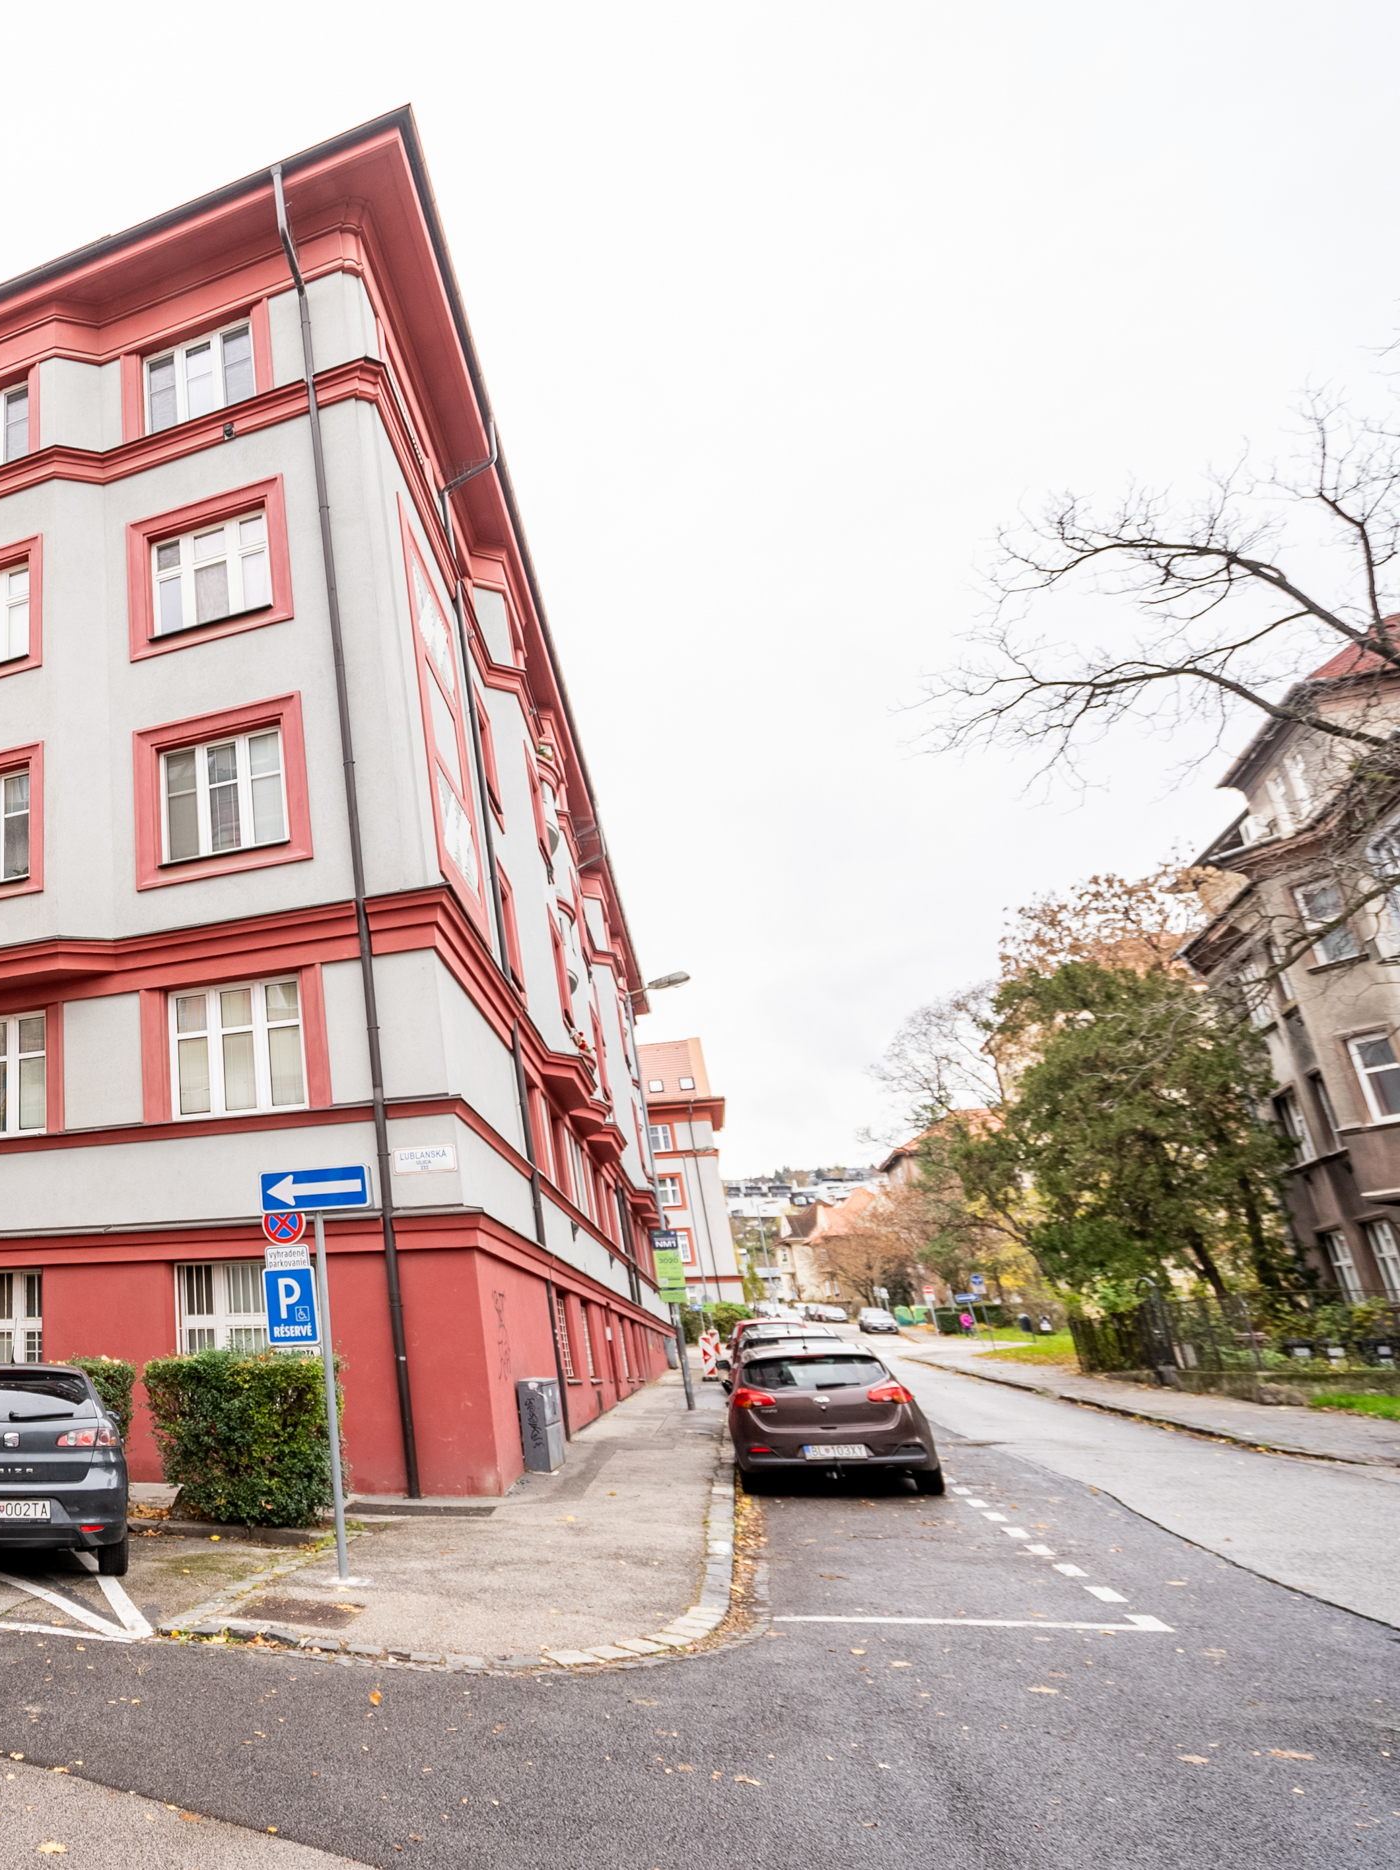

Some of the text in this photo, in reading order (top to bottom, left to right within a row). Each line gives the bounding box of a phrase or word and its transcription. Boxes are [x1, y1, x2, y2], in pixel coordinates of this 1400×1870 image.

[654, 1240, 677, 1248] NM1
[268, 1248, 306, 1260] vyhradené
[268, 1258, 307, 1268] parkovanie
[277, 1277, 301, 1320] P
[273, 1322, 313, 1338] RÉSERVÉ
